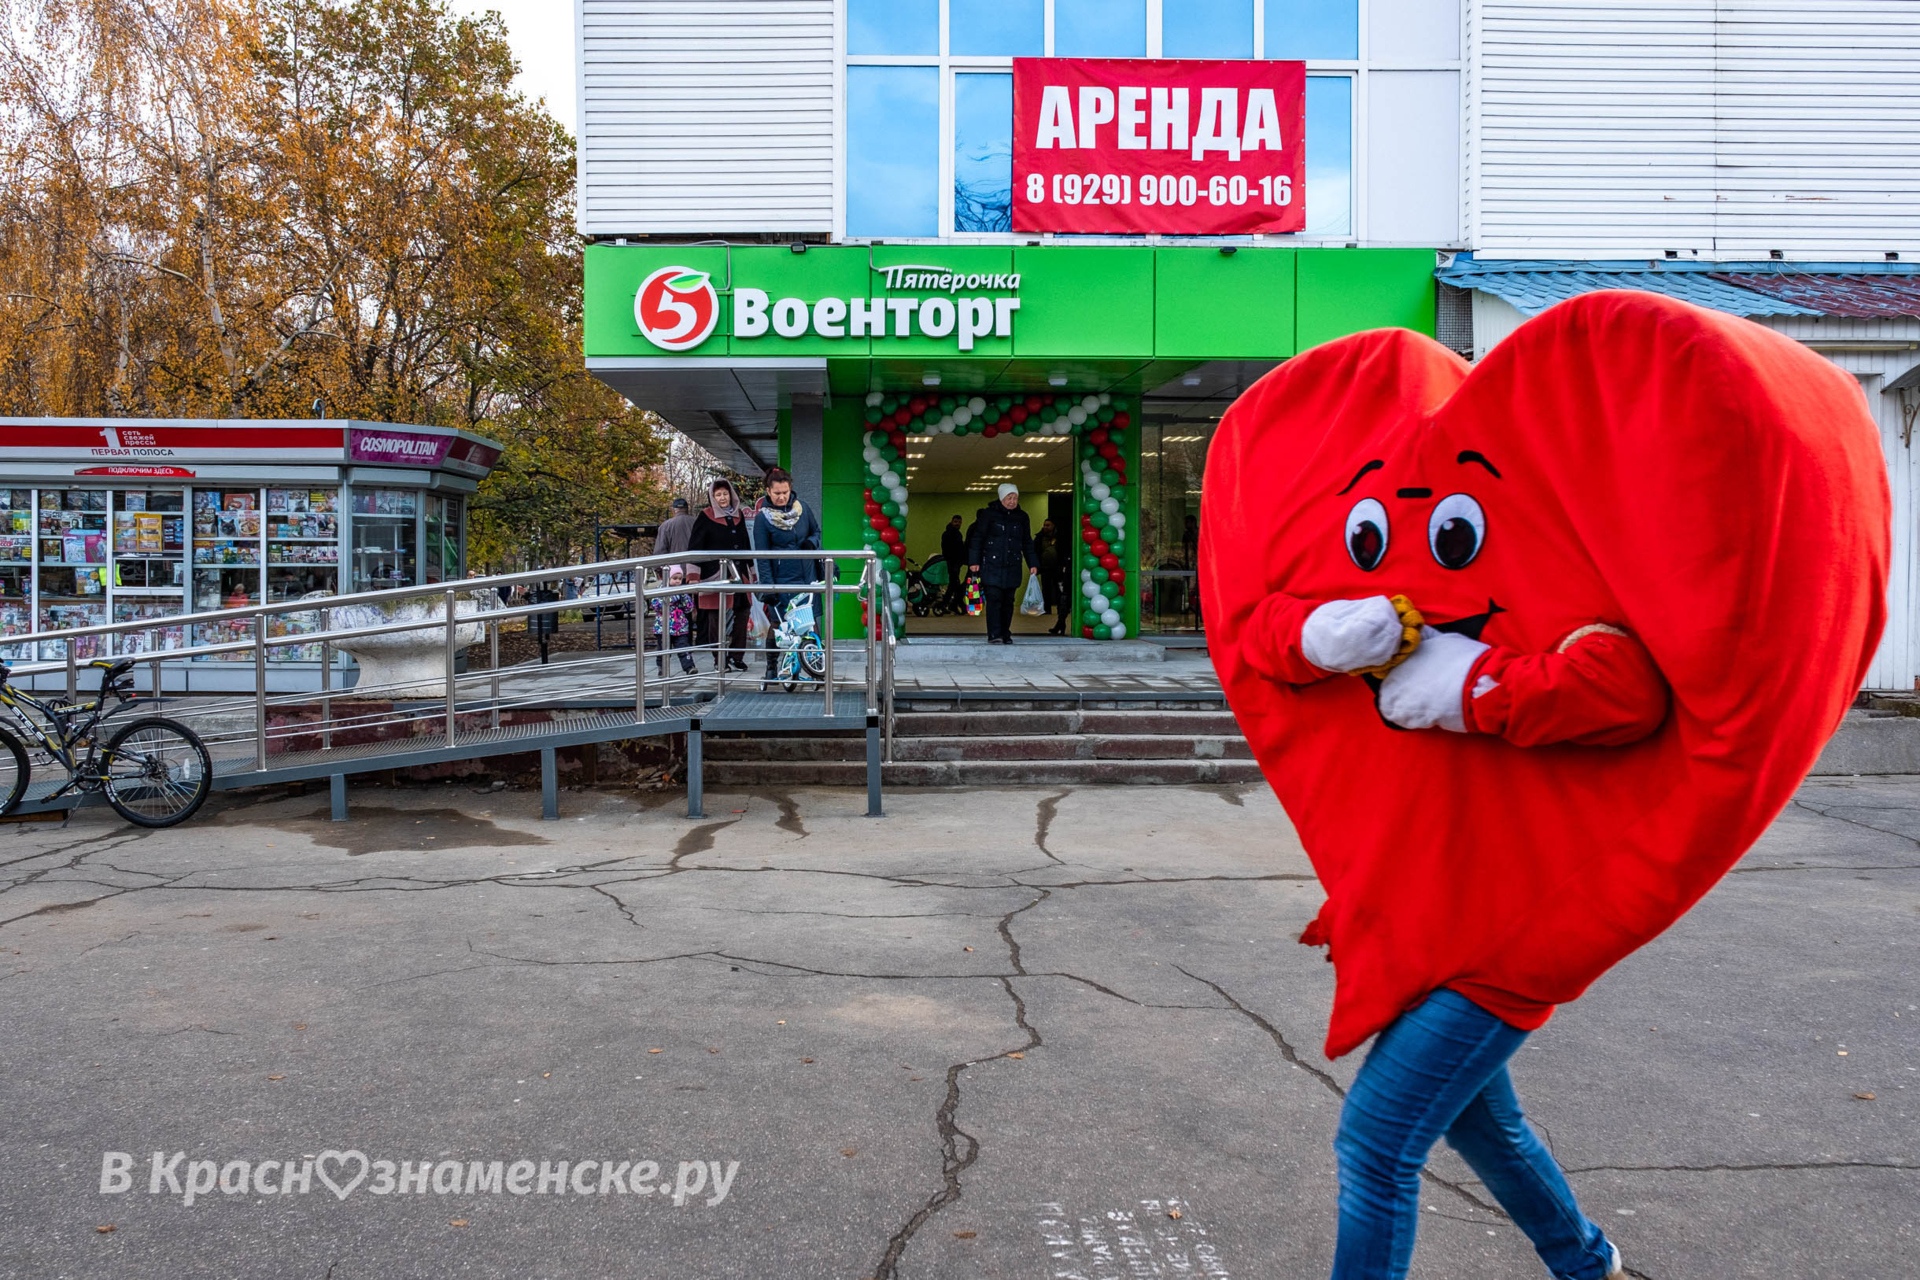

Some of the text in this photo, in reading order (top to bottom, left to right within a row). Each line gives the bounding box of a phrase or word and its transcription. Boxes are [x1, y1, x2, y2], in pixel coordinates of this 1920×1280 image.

[1036, 86, 1282, 161] АРЕНДА
[1026, 173, 1292, 206] 8 (929) 900-60-16
[880, 264, 1021, 294] Пятёрочка
[733, 288, 1021, 350] Военторг
[91, 448, 174, 456] ПЕРВАЯ ПОЛОСА
[99, 427, 121, 447] 1
[360, 437, 438, 456] COSMOPOLITAN
[11, 706, 46, 742] STELS
